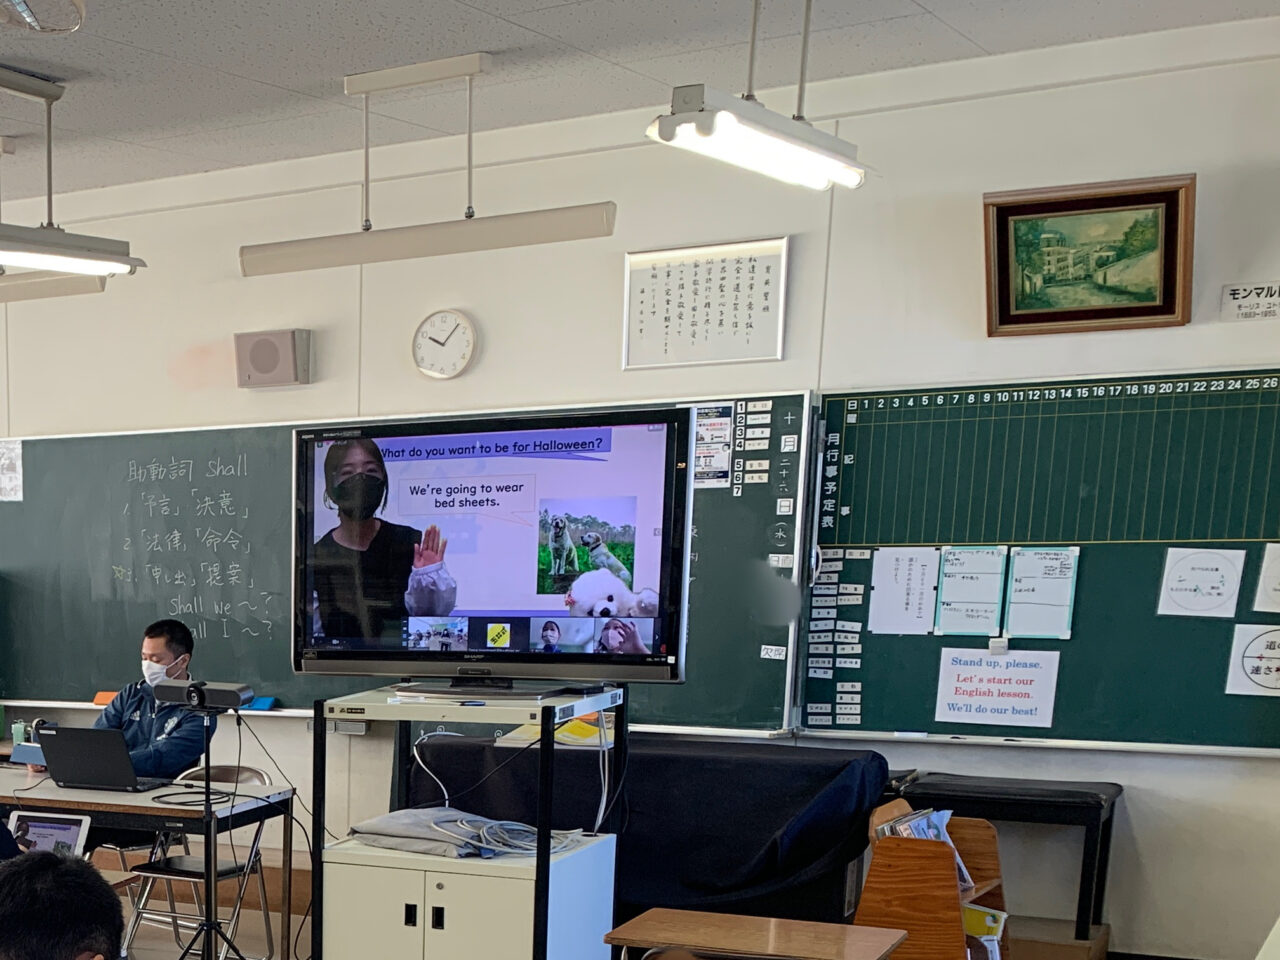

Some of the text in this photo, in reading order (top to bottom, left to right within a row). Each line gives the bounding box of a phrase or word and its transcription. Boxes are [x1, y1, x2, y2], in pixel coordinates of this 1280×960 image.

[848, 377, 1278, 409] 日 1 2 3 4 5 6 7 8 9 10 11 12 13 14 15 16 17 18 19 20 21 22 23 24 25 26
[409, 447, 422, 457] do
[425, 448, 446, 460] you
[448, 446, 476, 456] want
[479, 443, 492, 454] to
[495, 443, 509, 453] be
[512, 441, 531, 453] for
[533, 438, 603, 452] Halloween?
[128, 456, 193, 482] 助動詞
[409, 483, 524, 498] We're going to wear
[434, 496, 500, 508] bed sheets.
[185, 620, 207, 639] all
[762, 646, 786, 658] 欠席
[951, 657, 1042, 670] Stand up, please.
[1250, 665, 1272, 676] 速さ
[987, 676, 1012, 685] start
[954, 686, 1034, 699] English lesson.
[947, 702, 1038, 716] We'll do our best!
